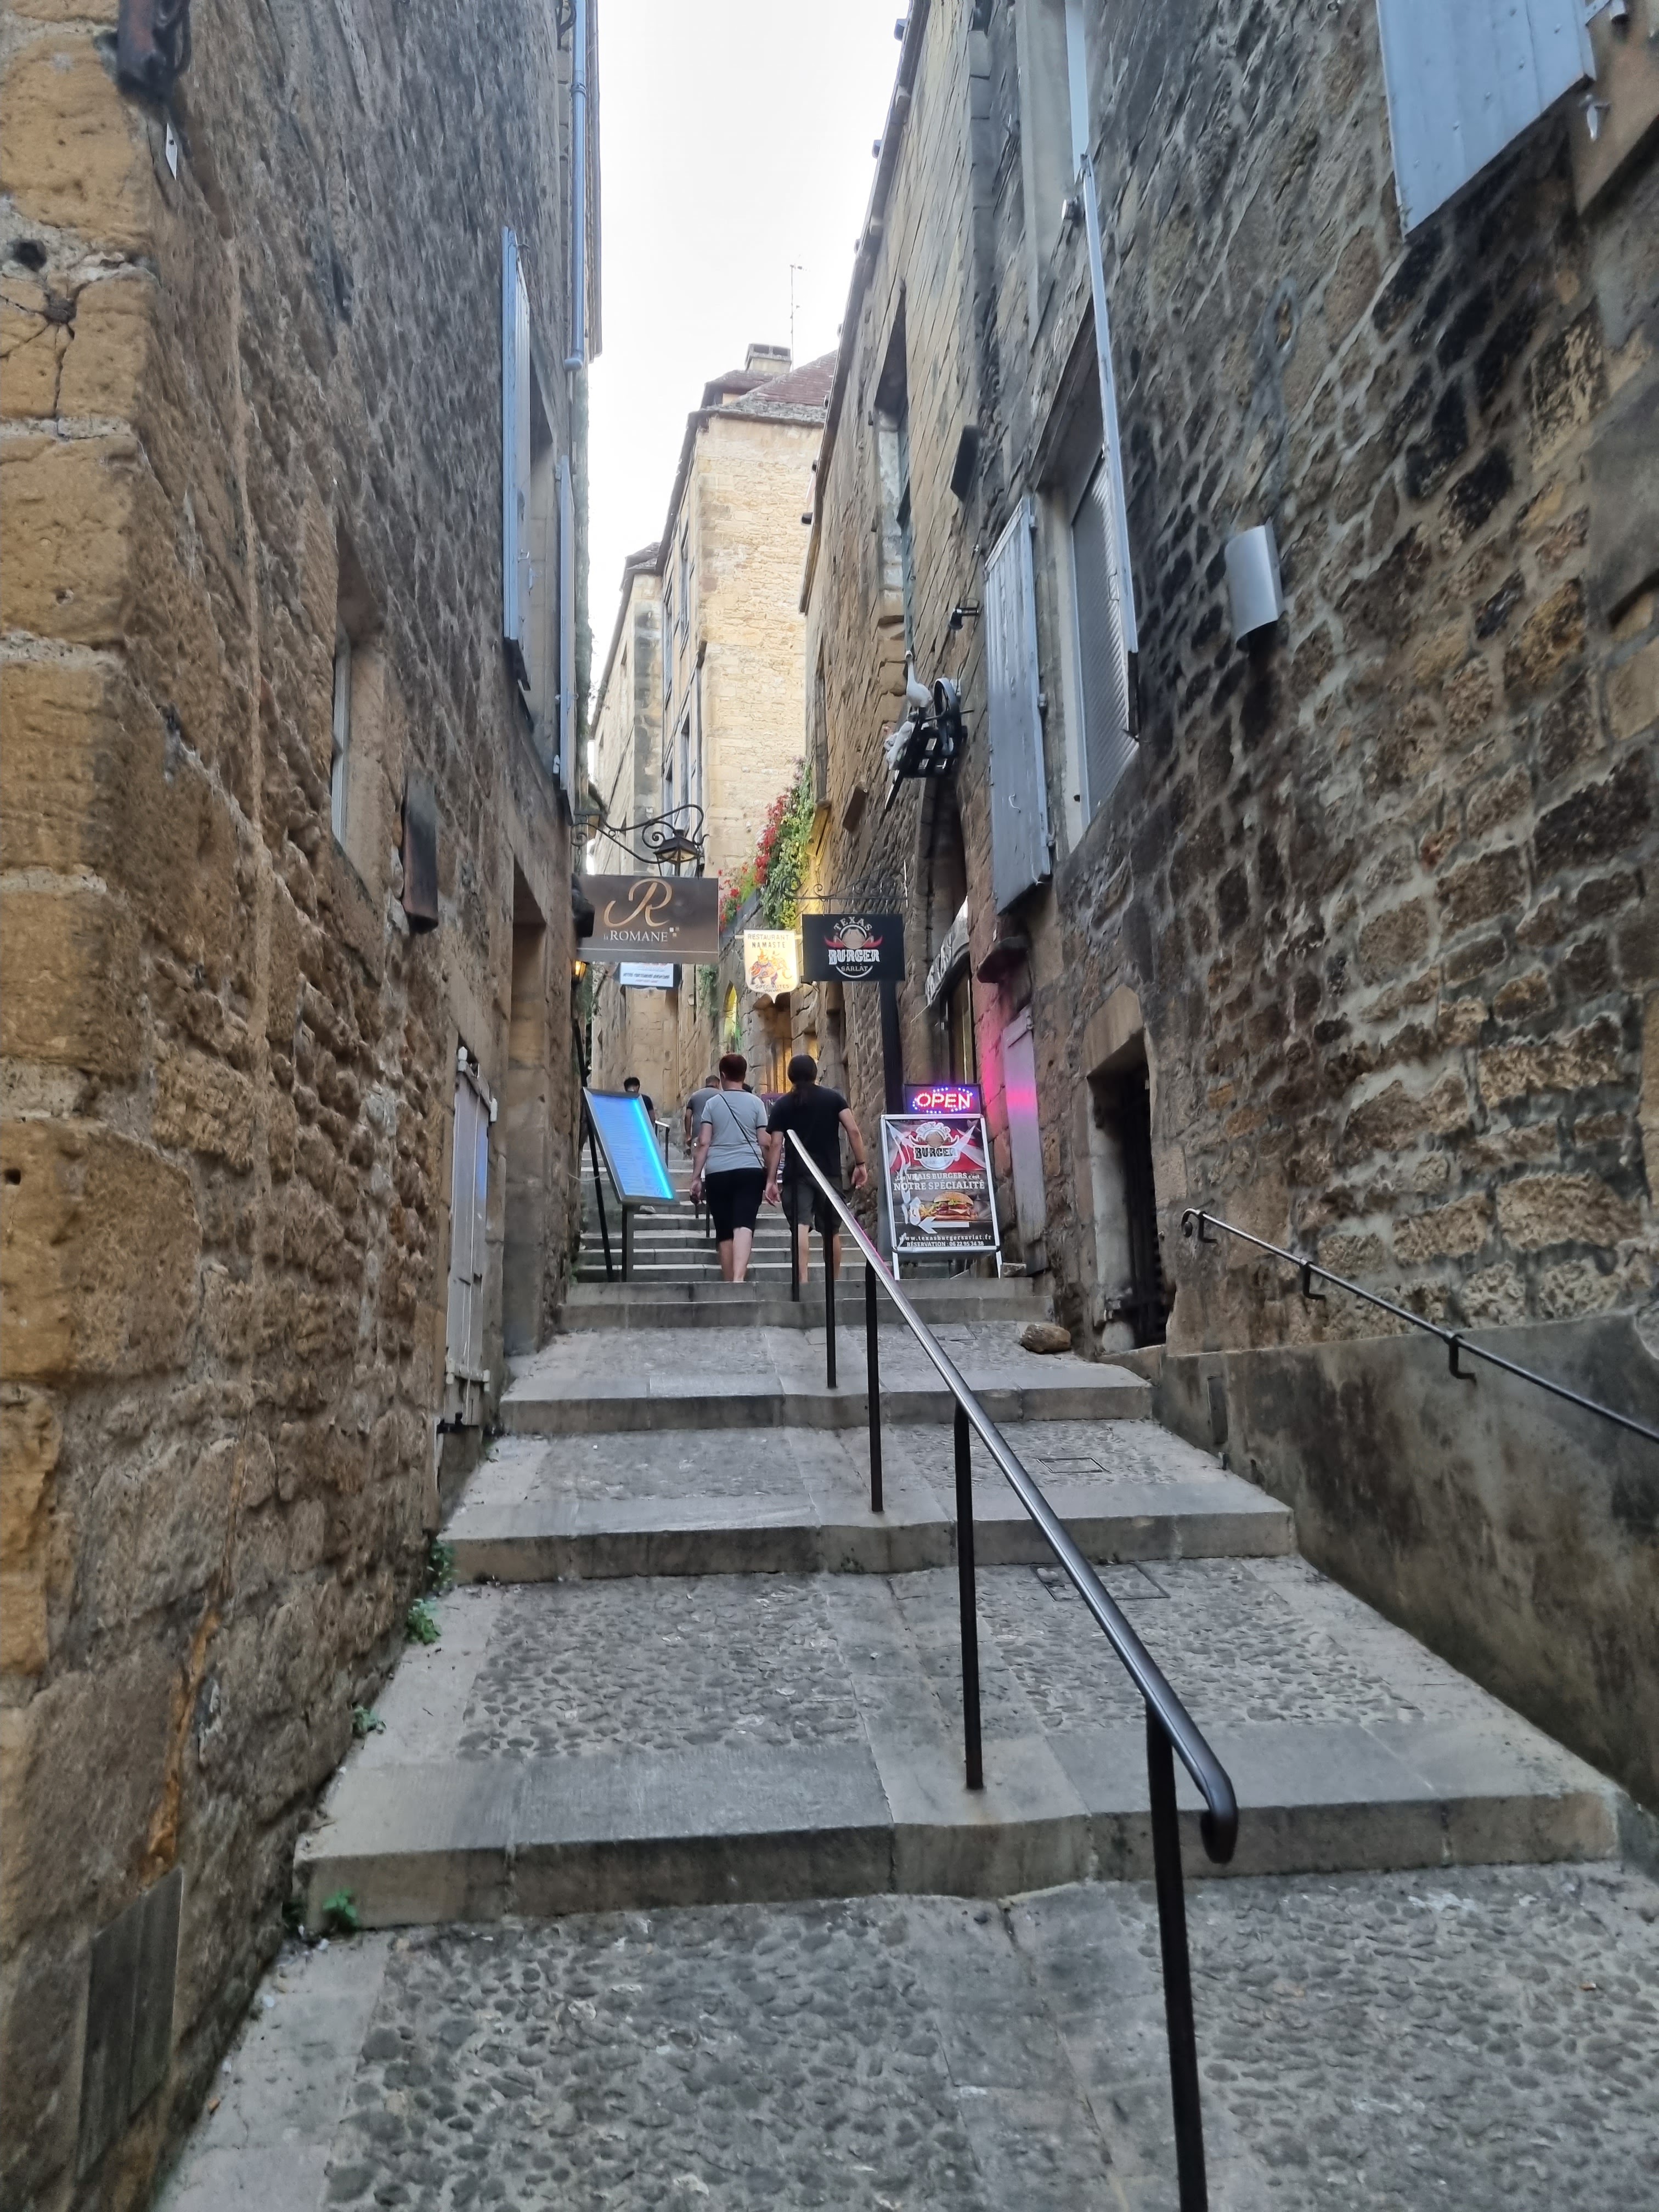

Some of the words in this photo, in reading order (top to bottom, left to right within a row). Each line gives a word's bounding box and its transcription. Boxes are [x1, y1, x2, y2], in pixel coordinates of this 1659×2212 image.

[833, 917, 873, 932] TEXAS
[610, 930, 668, 943] ROMANE
[828, 949, 881, 965] BURGER
[916, 1093, 970, 1109] OPEN
[915, 1147, 957, 1159] BURGER
[893, 1182, 927, 1190] NOTRE
[928, 1180, 985, 1190] SPÉCIALITÉ
